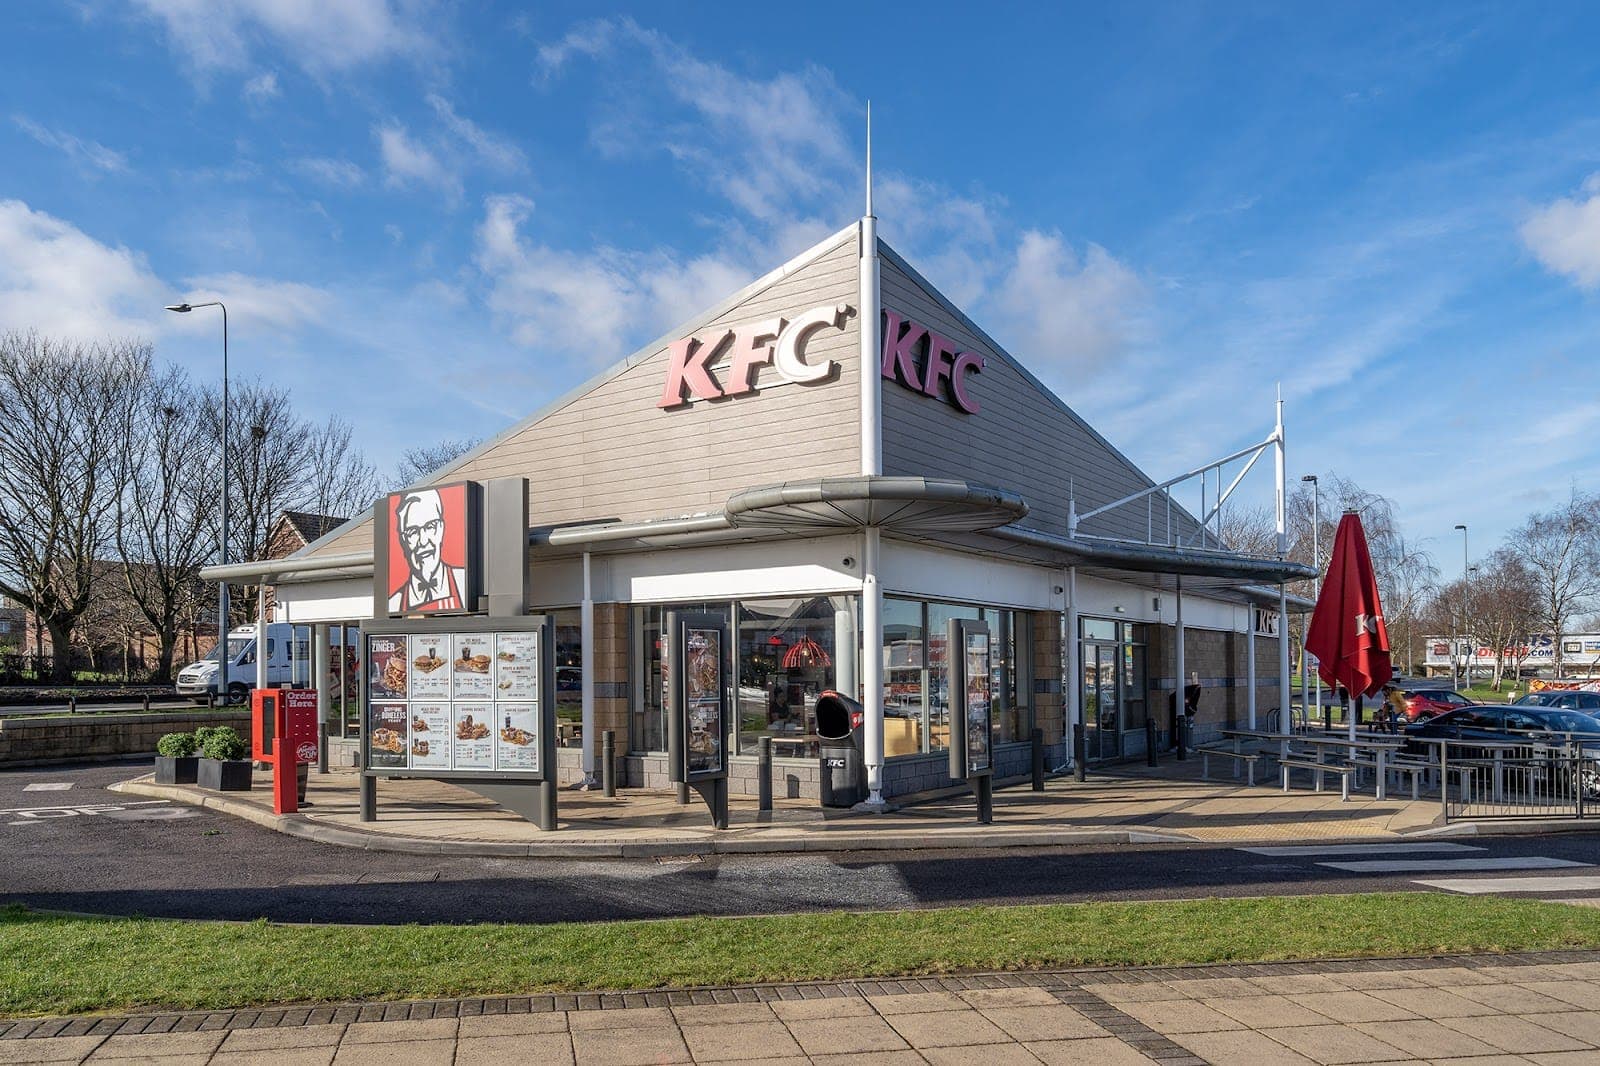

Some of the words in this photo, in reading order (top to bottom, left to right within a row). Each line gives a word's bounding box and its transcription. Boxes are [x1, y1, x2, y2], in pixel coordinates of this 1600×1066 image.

[656, 304, 847, 410] KFC
[881, 308, 987, 415] KFC
[1259, 608, 1280, 634] KFC
[371, 642, 395, 652] ZINGER
[287, 692, 317, 700] Order
[826, 759, 846, 767] KFC
[0, 806, 126, 818] OP
